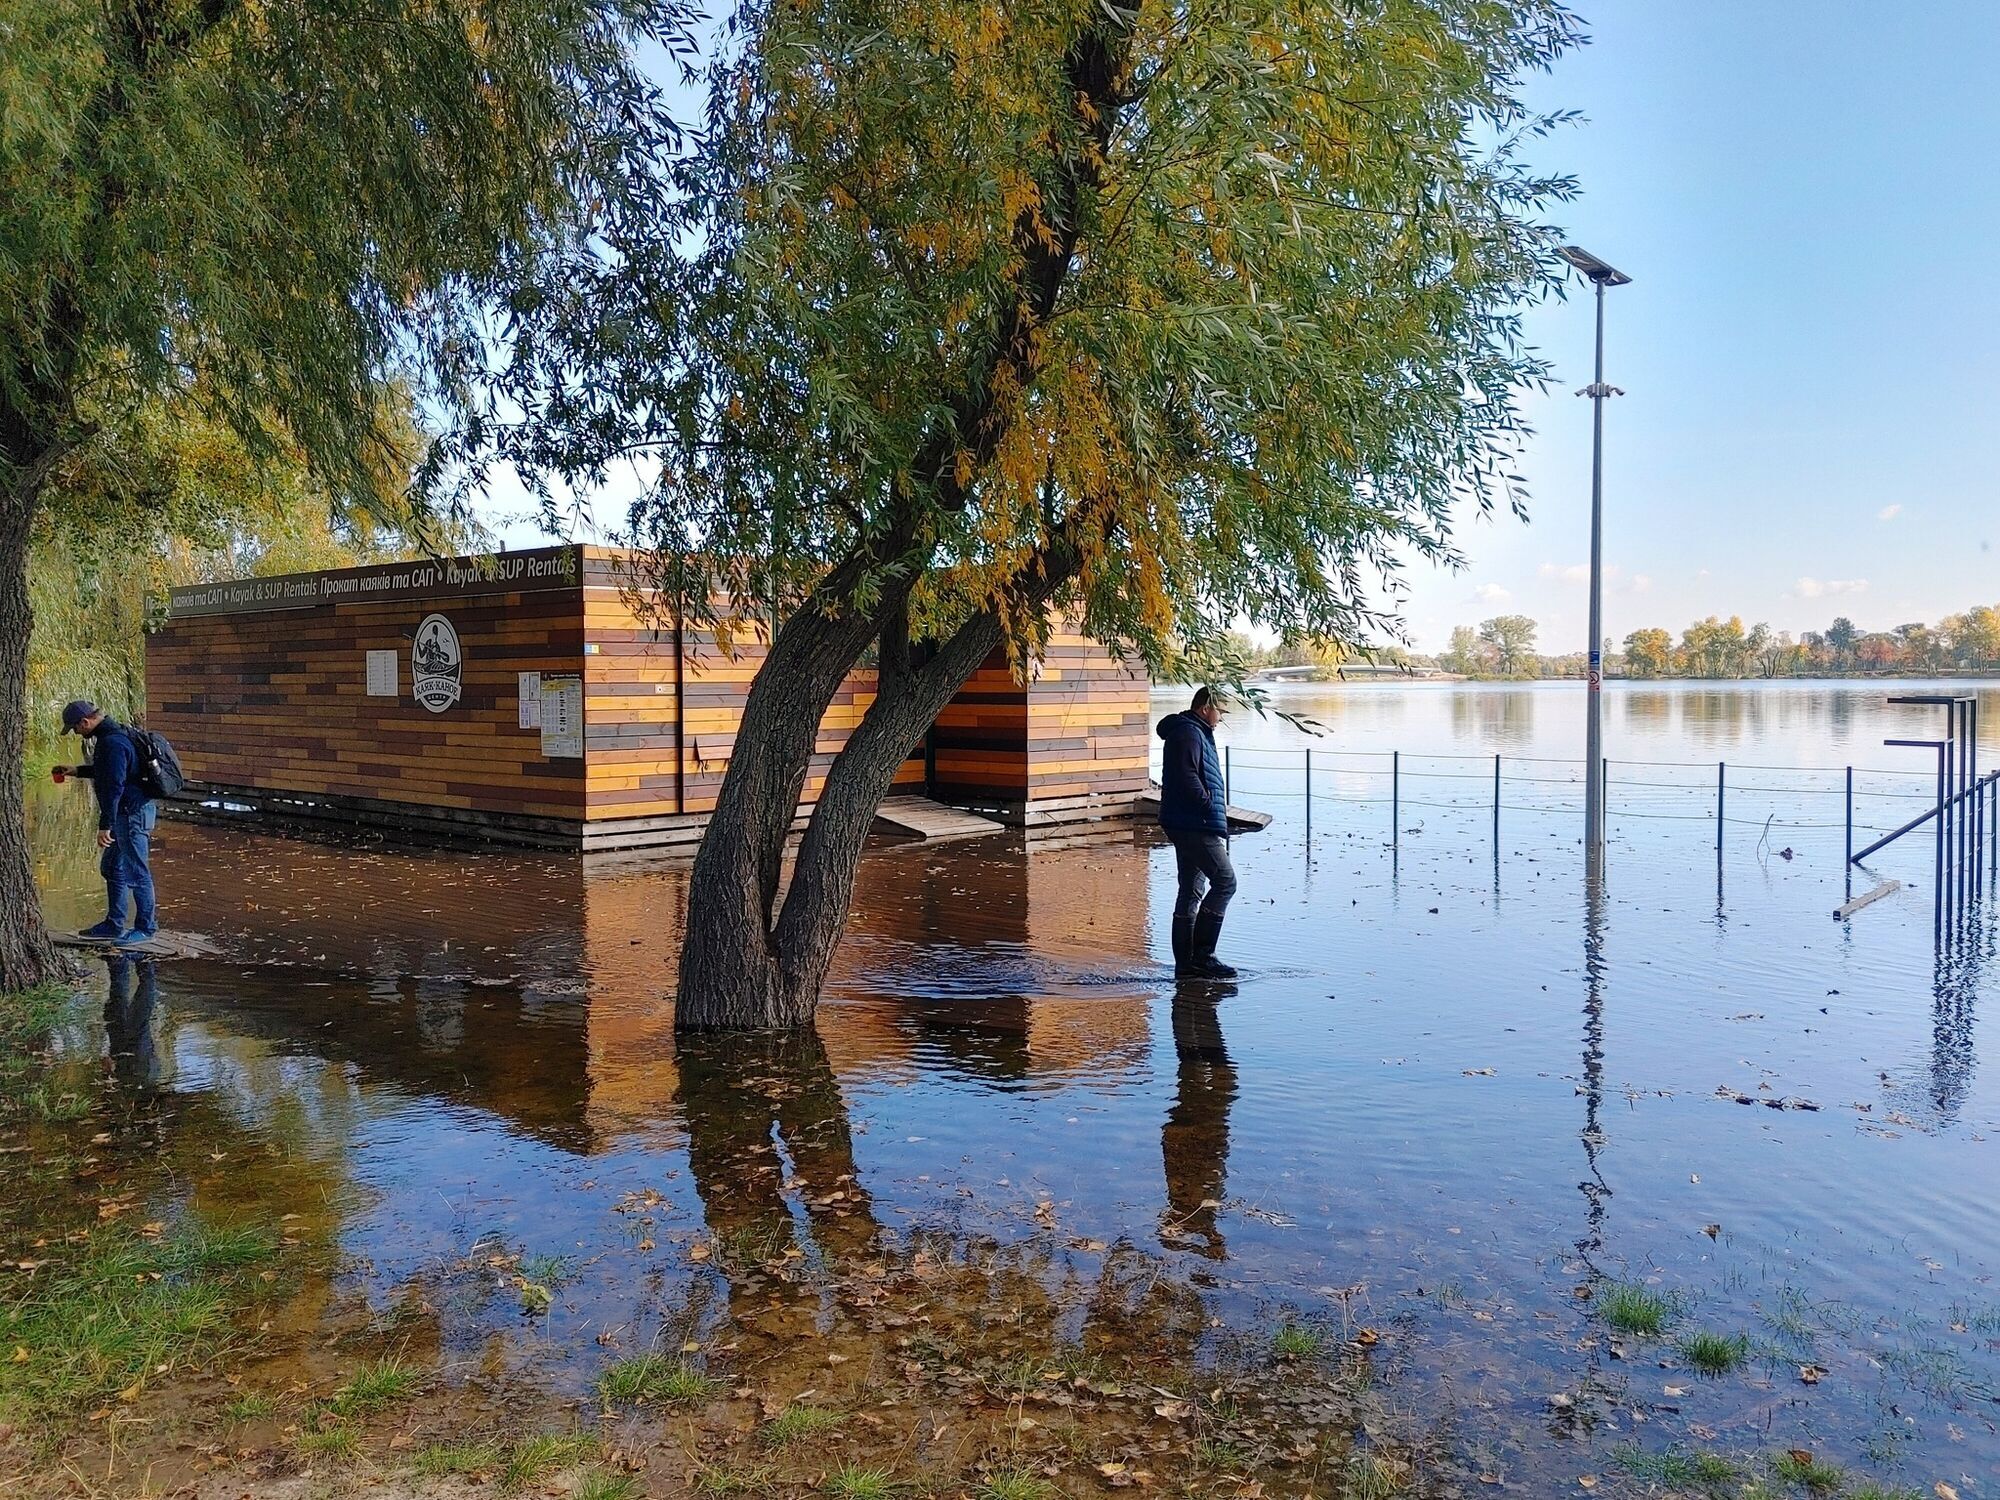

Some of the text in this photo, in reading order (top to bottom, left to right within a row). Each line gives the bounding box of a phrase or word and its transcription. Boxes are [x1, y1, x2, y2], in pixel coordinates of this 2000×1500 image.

[195, 595, 207, 607] та
[207, 588, 222, 605] САП
[230, 586, 254, 606] Kayak
[256, 583, 263, 600] &
[265, 582, 282, 600] SUP
[284, 577, 317, 598] Rentals
[320, 577, 359, 598] Прокат
[360, 571, 391, 591] каяків
[392, 574, 409, 589] та
[412, 568, 434, 588] САП
[499, 558, 524, 581] SUP
[528, 557, 576, 578] Rentas
